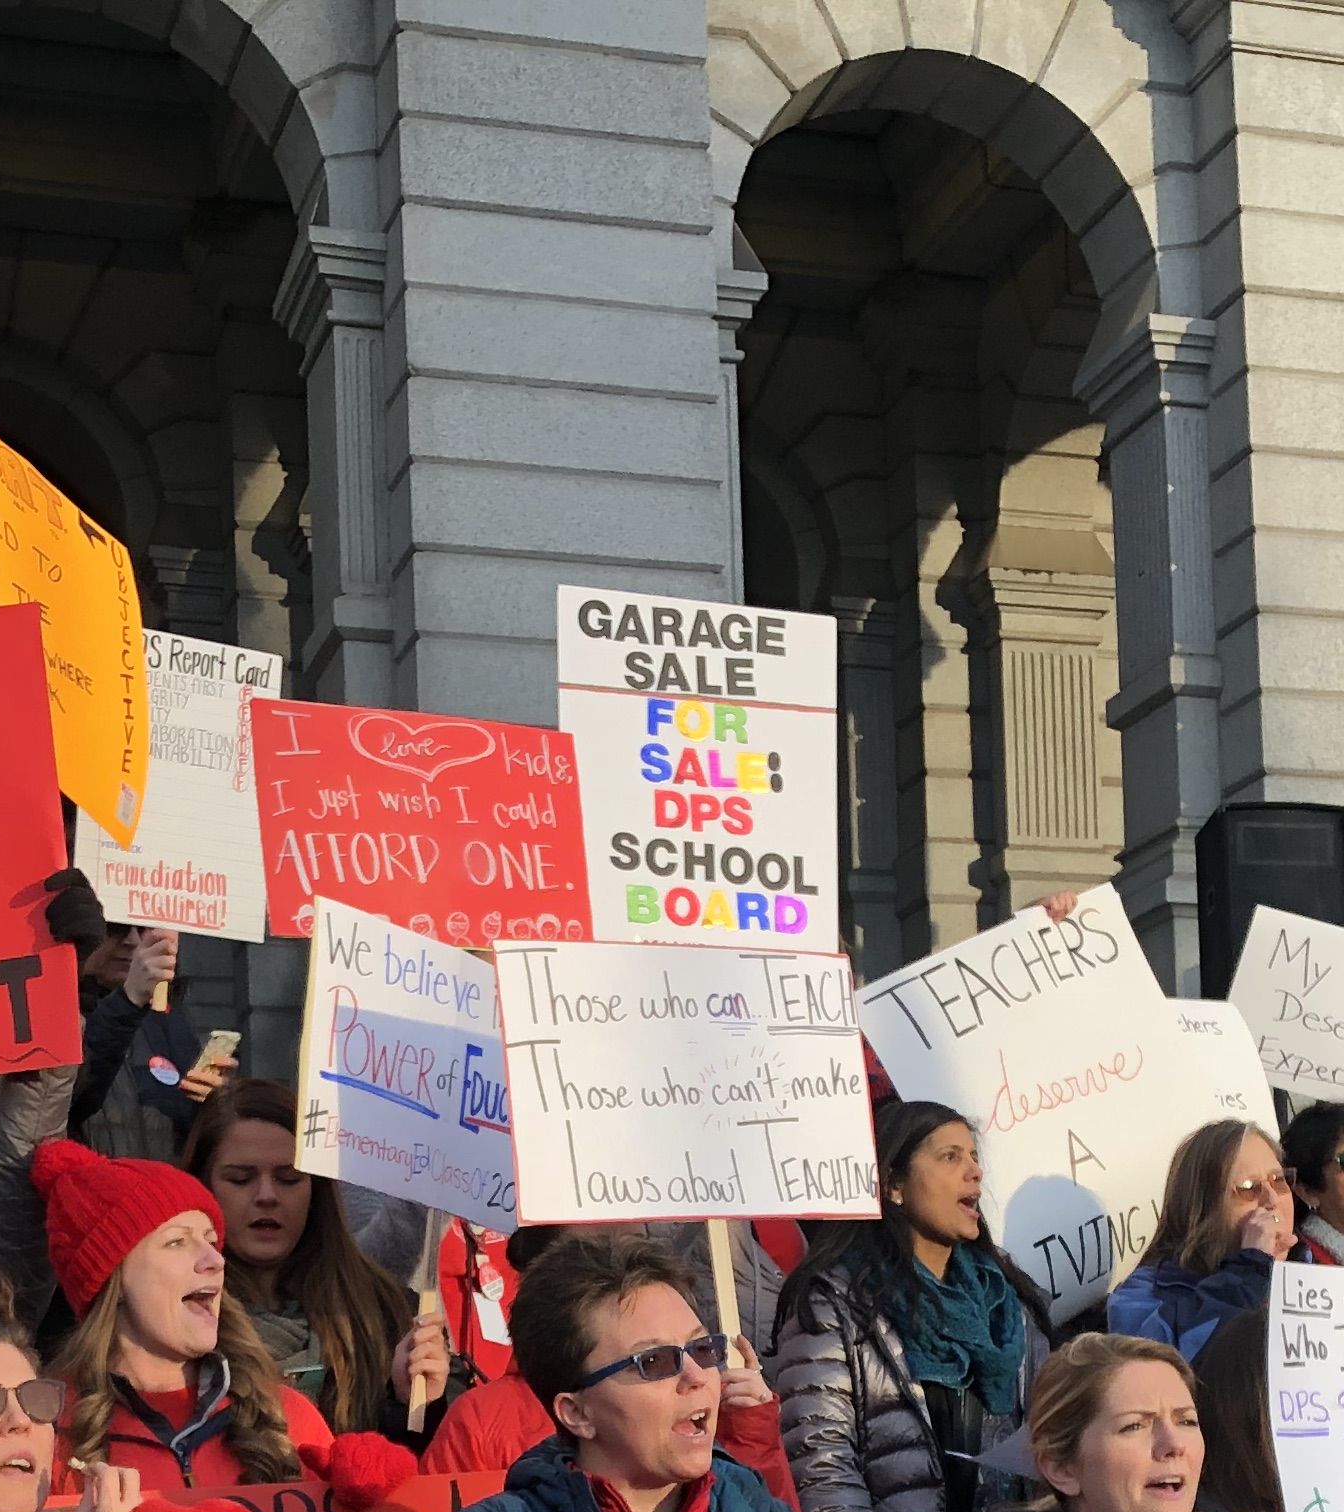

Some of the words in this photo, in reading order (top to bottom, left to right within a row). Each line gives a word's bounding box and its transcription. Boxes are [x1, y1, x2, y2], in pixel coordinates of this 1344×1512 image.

[31, 545, 63, 583] TO
[578, 599, 787, 657] GARAGE
[45, 648, 95, 696] WHERE
[169, 638, 227, 681] Report
[235, 653, 273, 689] Card
[623, 651, 757, 697] SALE
[271, 709, 321, 756] I
[379, 732, 452, 759] love
[646, 697, 748, 744] FOR
[639, 743, 784, 795] SALE:
[270, 779, 296, 817] I
[308, 774, 362, 820] just
[378, 782, 442, 819] wish
[449, 786, 479, 824] I
[492, 792, 557, 830] could
[654, 789, 754, 836] DPS
[105, 860, 227, 898] remediation
[274, 829, 440, 896] AFFORD
[463, 841, 575, 892] ONE.
[609, 832, 819, 896] SCHOOL
[625, 884, 808, 935] BOARD
[325, 911, 373, 976] We
[383, 934, 481, 1020] believe
[497, 947, 627, 1028] Those
[639, 970, 699, 1021] who
[738, 952, 858, 1026] TEACH
[862, 905, 1122, 1051] TEACHERS
[1268, 928, 1332, 998] My
[436, 1058, 458, 1098] of
[506, 1038, 633, 1114] Those
[640, 1060, 702, 1108] who
[790, 1058, 864, 1101] make
[978, 1043, 1145, 1134] deserve
[666, 1148, 748, 1206] about
[736, 1116, 881, 1205] TEACHING
[1067, 1127, 1107, 1188] A
[1282, 1265, 1334, 1312] Lies
[1282, 1322, 1329, 1362] Who
